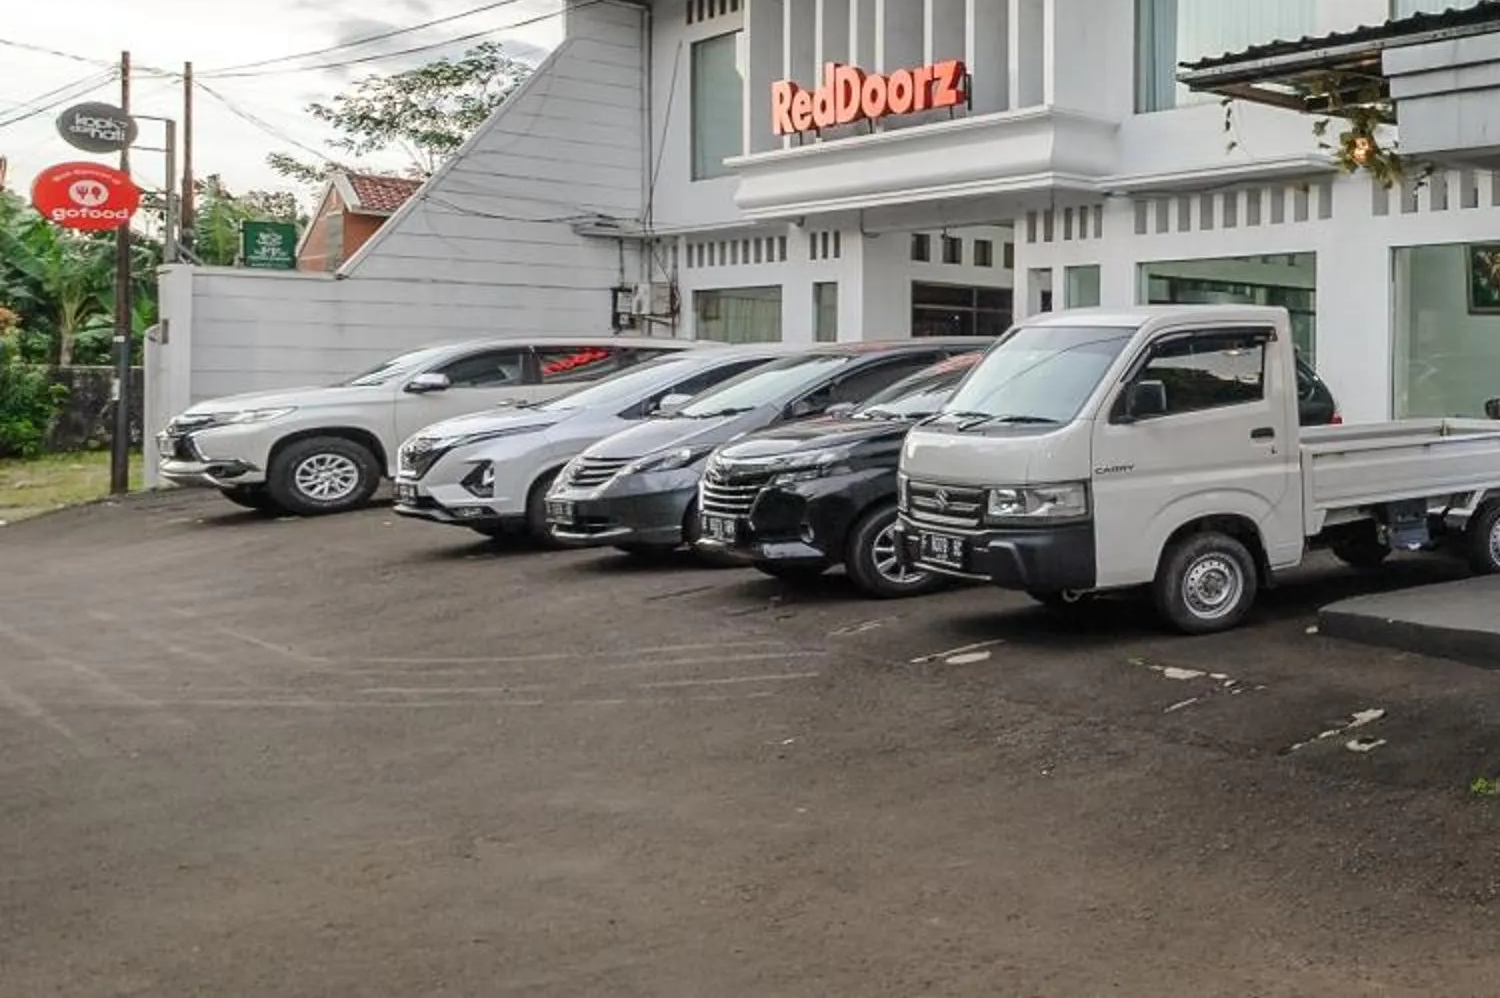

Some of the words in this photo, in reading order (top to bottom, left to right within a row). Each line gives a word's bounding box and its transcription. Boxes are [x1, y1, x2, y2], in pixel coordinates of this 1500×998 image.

[772, 59, 964, 135] RedDoorz
[51, 208, 129, 221] gofood
[1095, 463, 1135, 475] CARRY
